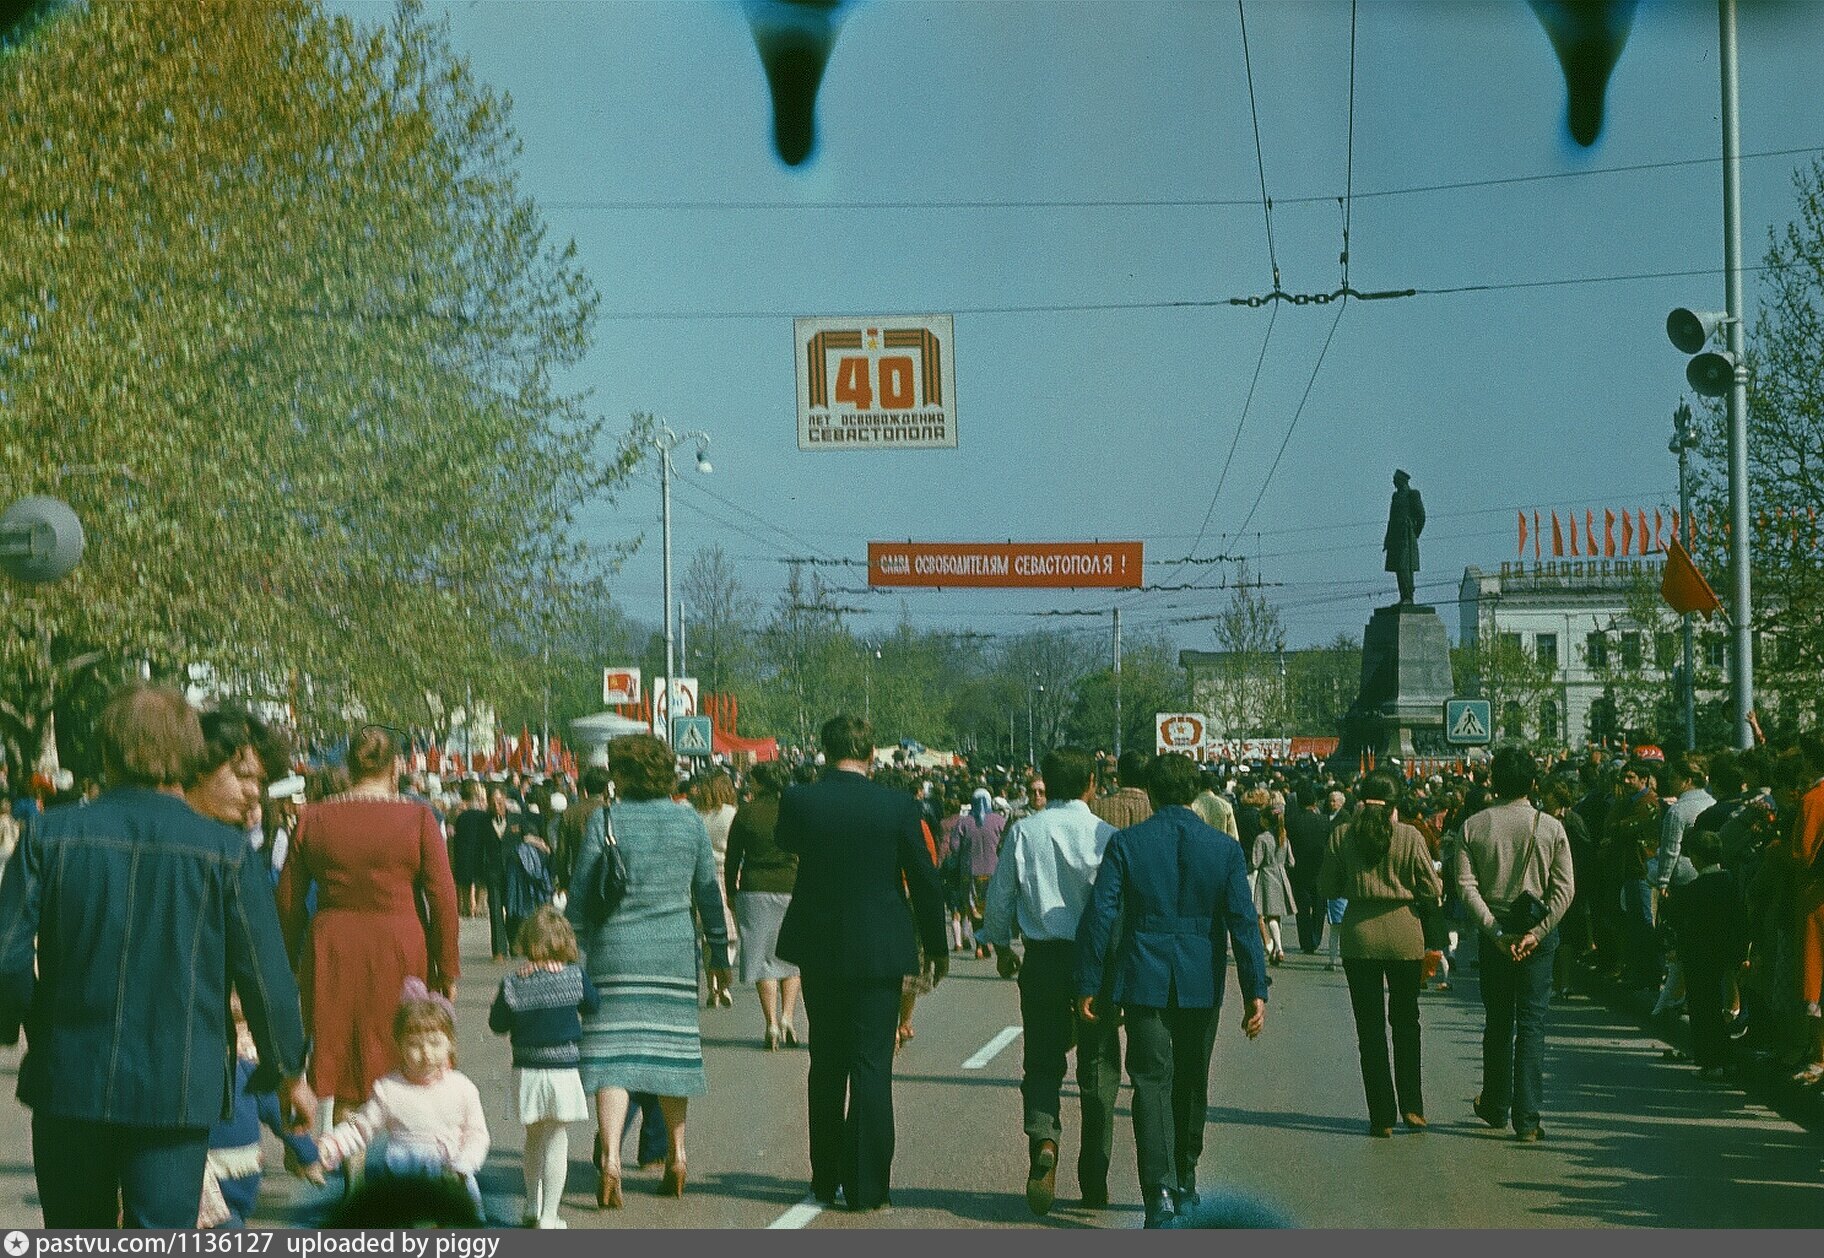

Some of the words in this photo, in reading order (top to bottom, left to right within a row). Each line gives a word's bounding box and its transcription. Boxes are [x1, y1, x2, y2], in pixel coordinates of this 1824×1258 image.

[835, 355, 915, 411] 40
[809, 413, 831, 426] ЛЕТ
[841, 411, 945, 426] ОСВОБОЖДЕНИЯ
[808, 425, 946, 443] СЕВАСТОПОЛЯ
[880, 554, 910, 575] СЛАВА
[915, 554, 1009, 576] ОСВОБОДИТЕЛЯМ
